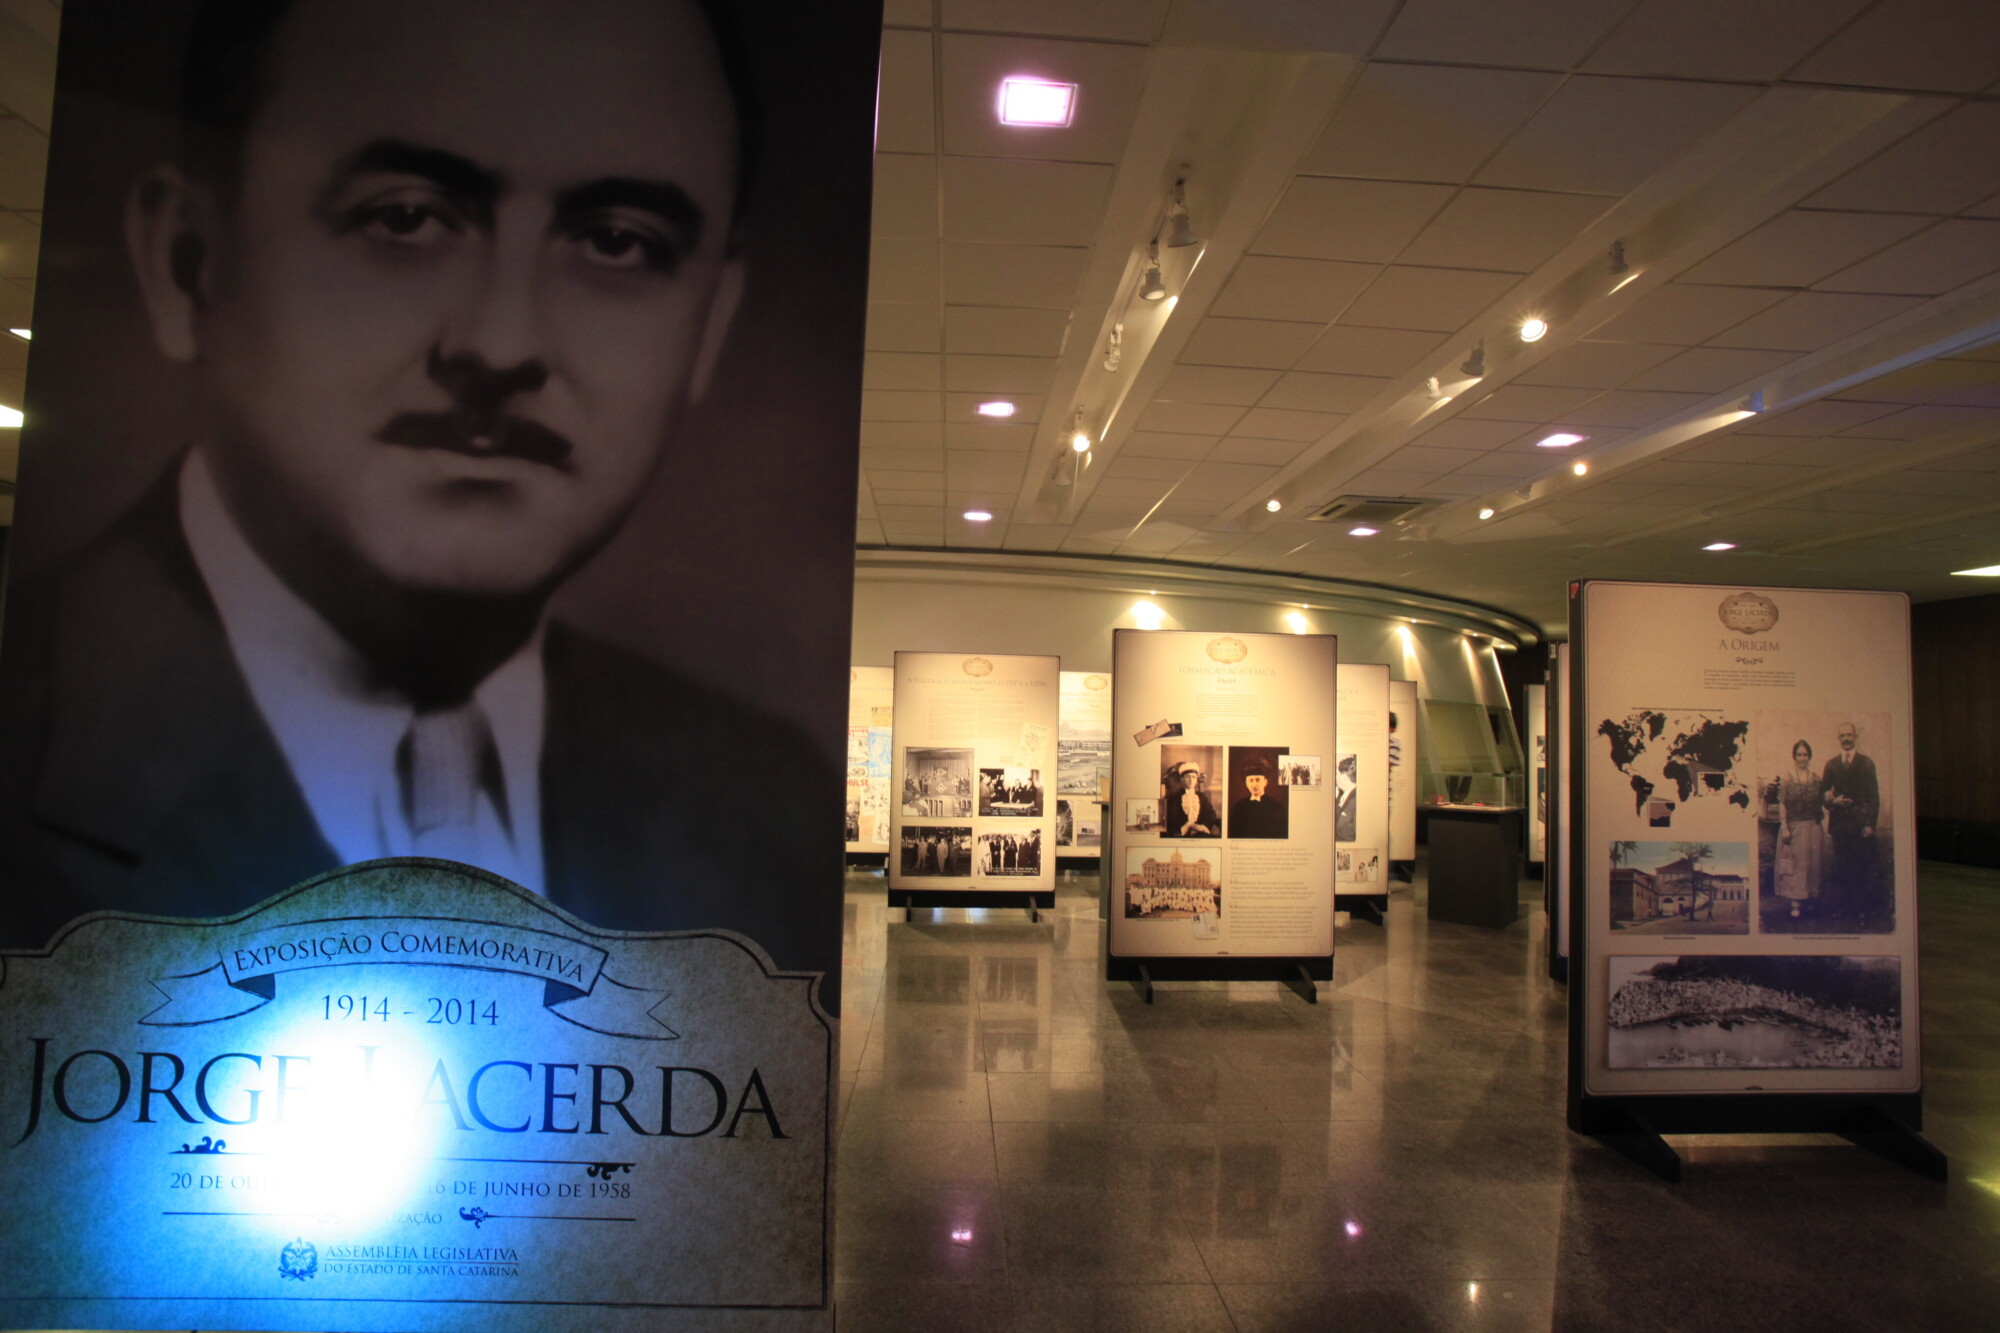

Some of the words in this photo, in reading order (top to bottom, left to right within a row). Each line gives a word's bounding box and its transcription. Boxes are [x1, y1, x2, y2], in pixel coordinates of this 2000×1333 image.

[1719, 639, 1728, 650] A
[1731, 639, 1780, 651] ORIGEM
[233, 931, 372, 971] EXPOSIÇÃO
[381, 930, 584, 982] COMEMORATIVA
[321, 993, 391, 1022] 1914
[427, 996, 500, 1026] 2014
[170, 1171, 192, 1190] 20
[200, 1174, 223, 1190] DE
[454, 1180, 478, 1195] DE
[484, 1181, 551, 1199] JUNHO
[558, 1183, 582, 1198] DE
[591, 1182, 631, 1200] 1958
[424, 1247, 518, 1262] LEGISLATIVA
[324, 1263, 343, 1274] DO
[347, 1263, 394, 1275] ESTADO
[397, 1264, 413, 1275] DE
[417, 1265, 455, 1276] SANTA
[458, 1265, 519, 1278] CATARINA
